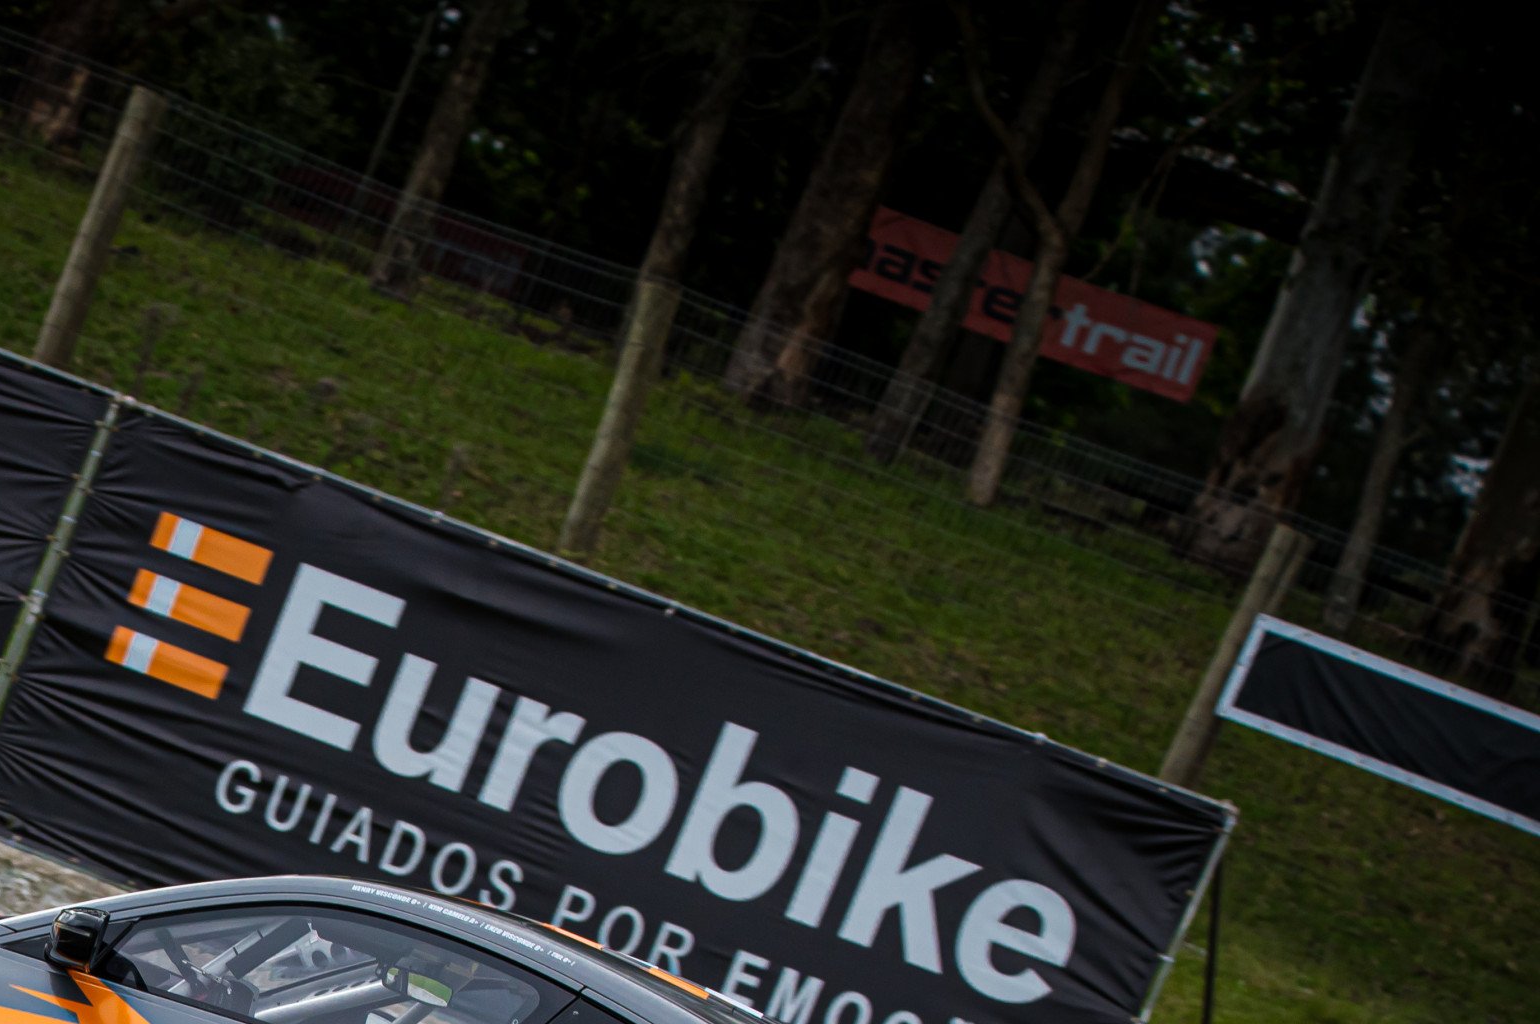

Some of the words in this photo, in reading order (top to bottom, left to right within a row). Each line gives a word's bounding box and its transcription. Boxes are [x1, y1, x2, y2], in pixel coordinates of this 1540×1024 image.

[217, 761, 523, 911] GUIADOS
[549, 885, 696, 976] POR
[243, 563, 1075, 1003] Eurobike
